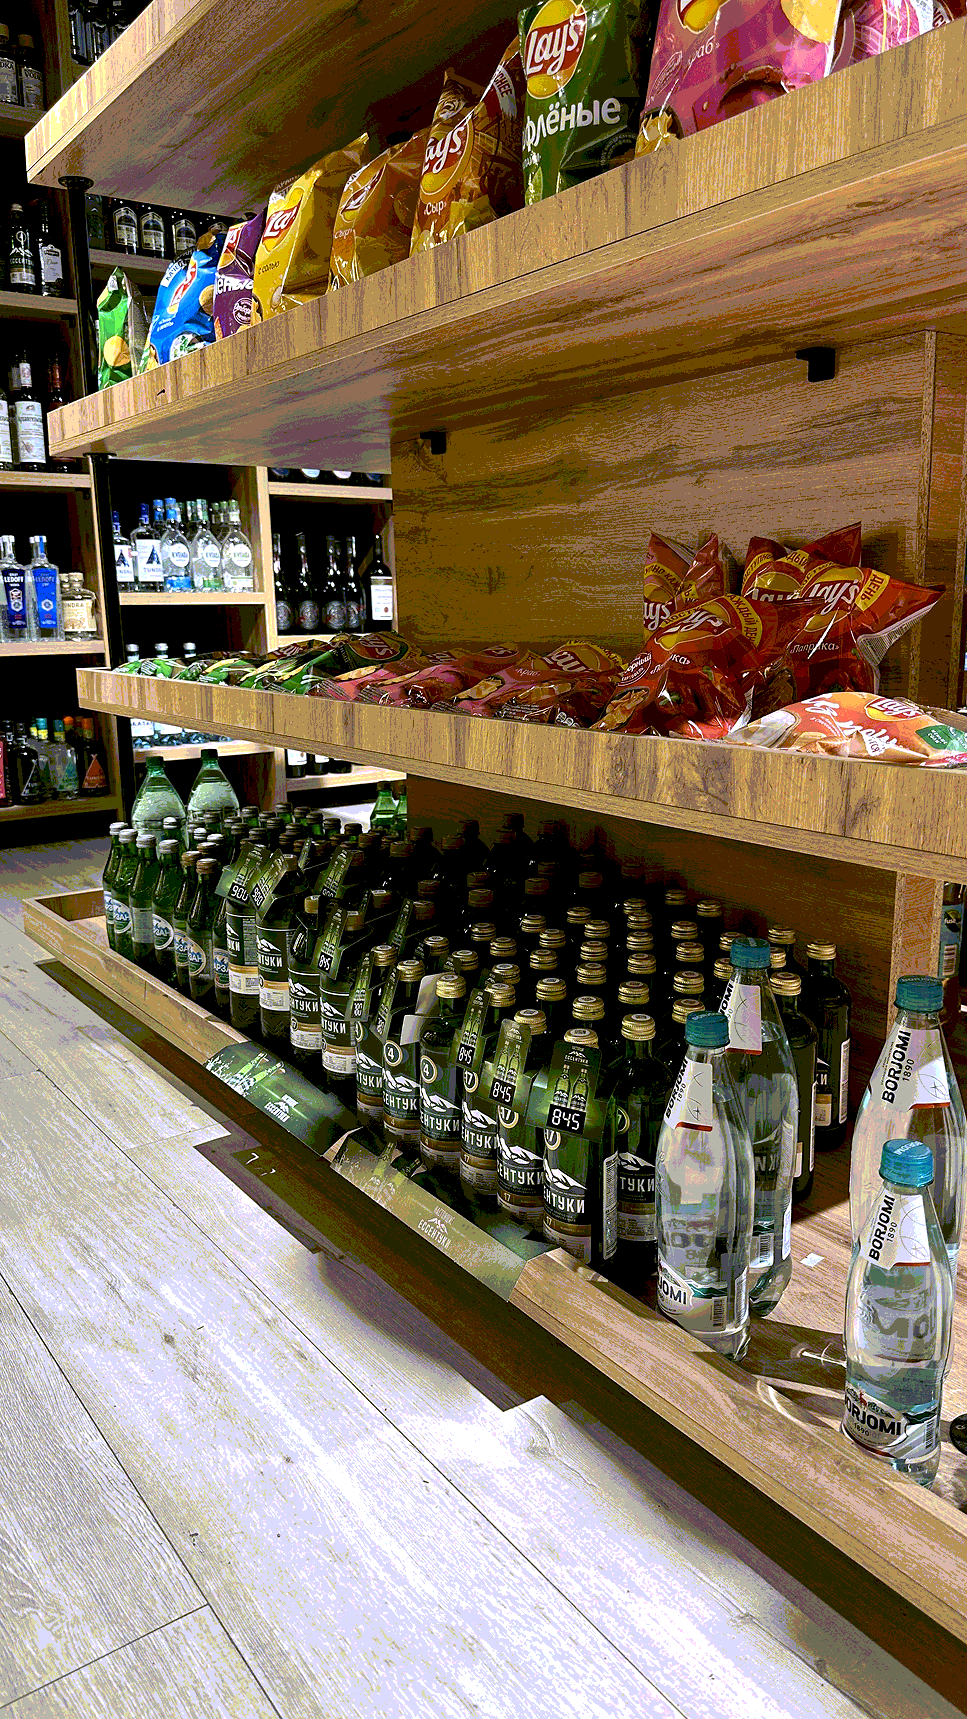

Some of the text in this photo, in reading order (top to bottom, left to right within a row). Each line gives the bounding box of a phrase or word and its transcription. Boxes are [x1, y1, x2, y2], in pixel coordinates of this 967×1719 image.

[861, 574, 884, 601] ДЕНЬ
[459, 1047, 473, 1064] 845
[881, 1030, 911, 1104] BORJOMI
[902, 1059, 914, 1082] 1890
[493, 1082, 511, 1103] 845
[665, 1060, 688, 1118] BORJOMI
[552, 1108, 580, 1131] 845
[869, 1194, 895, 1261] BORJOMI
[886, 1221, 898, 1242] 1890
[844, 1395, 902, 1436] ORJOMI
